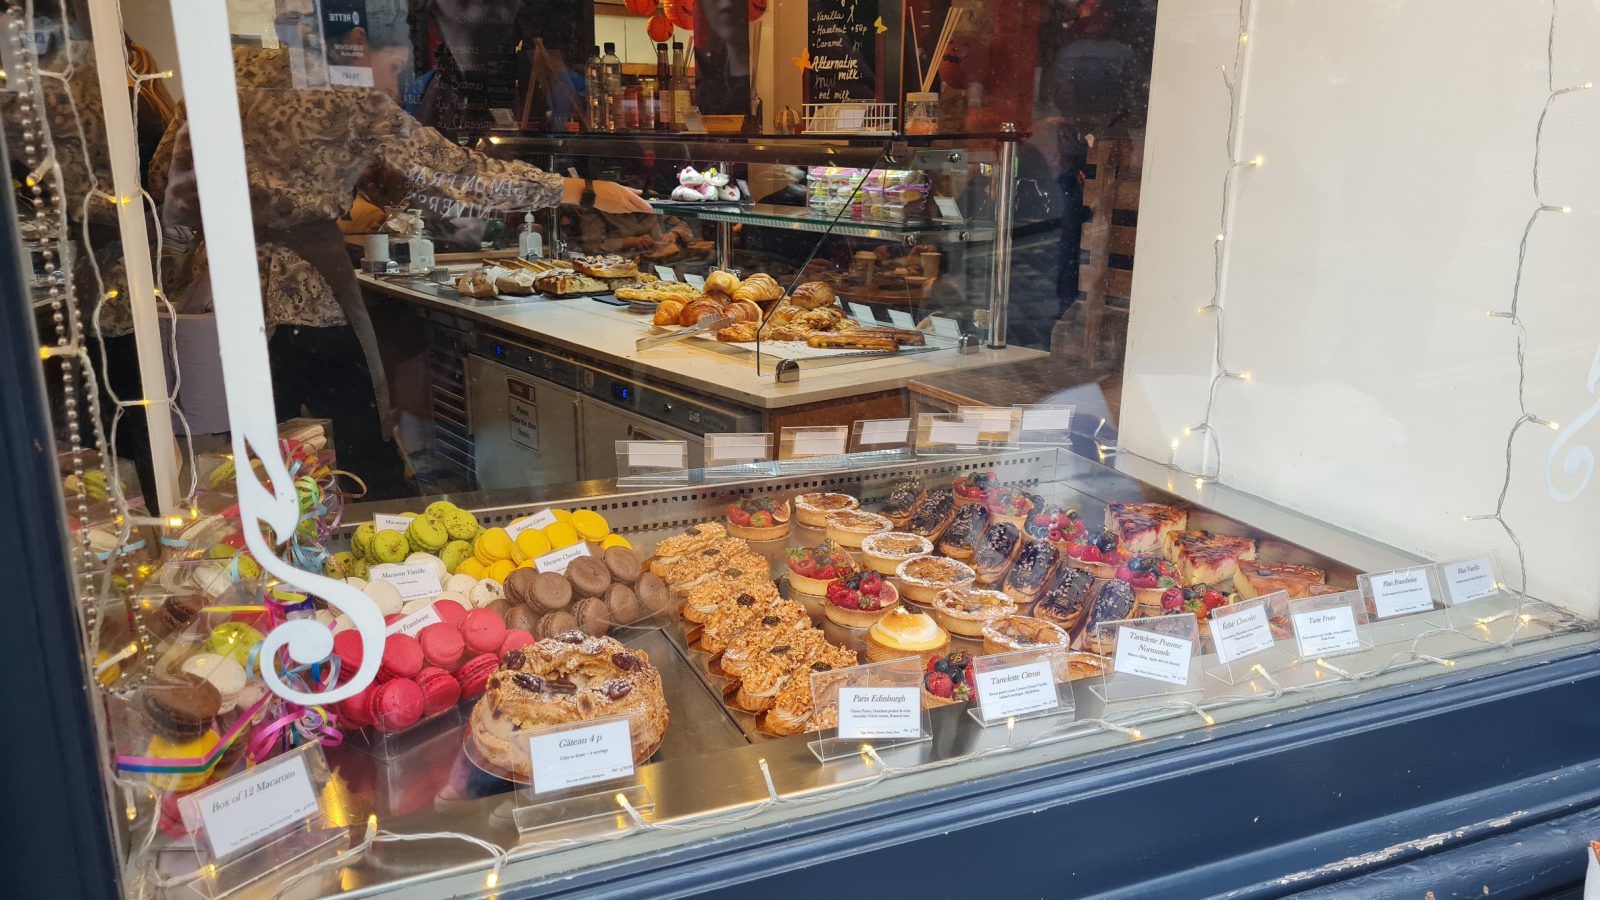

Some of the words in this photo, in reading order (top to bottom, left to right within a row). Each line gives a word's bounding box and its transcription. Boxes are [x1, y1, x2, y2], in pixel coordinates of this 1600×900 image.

[816, 10, 845, 21] Vanilla
[812, 54, 858, 73] Alternative
[543, 557, 562, 568] Macaron
[381, 571, 406, 579] Macaron
[1383, 580, 1394, 588] Flan
[402, 613, 430, 632] Framboise
[1129, 631, 1159, 645] Tartelette
[1158, 638, 1183, 650] Pomme
[1138, 643, 1172, 657] Normande
[990, 673, 1020, 685] Tartelette
[1021, 670, 1041, 680] Citron
[853, 694, 870, 703] Paris
[871, 694, 906, 704] Edinburgh
[558, 736, 587, 749] Gâteau
[211, 800, 230, 813] Box
[231, 791, 243, 804] of
[243, 786, 255, 799] 12
[256, 770, 297, 794] Macarons
